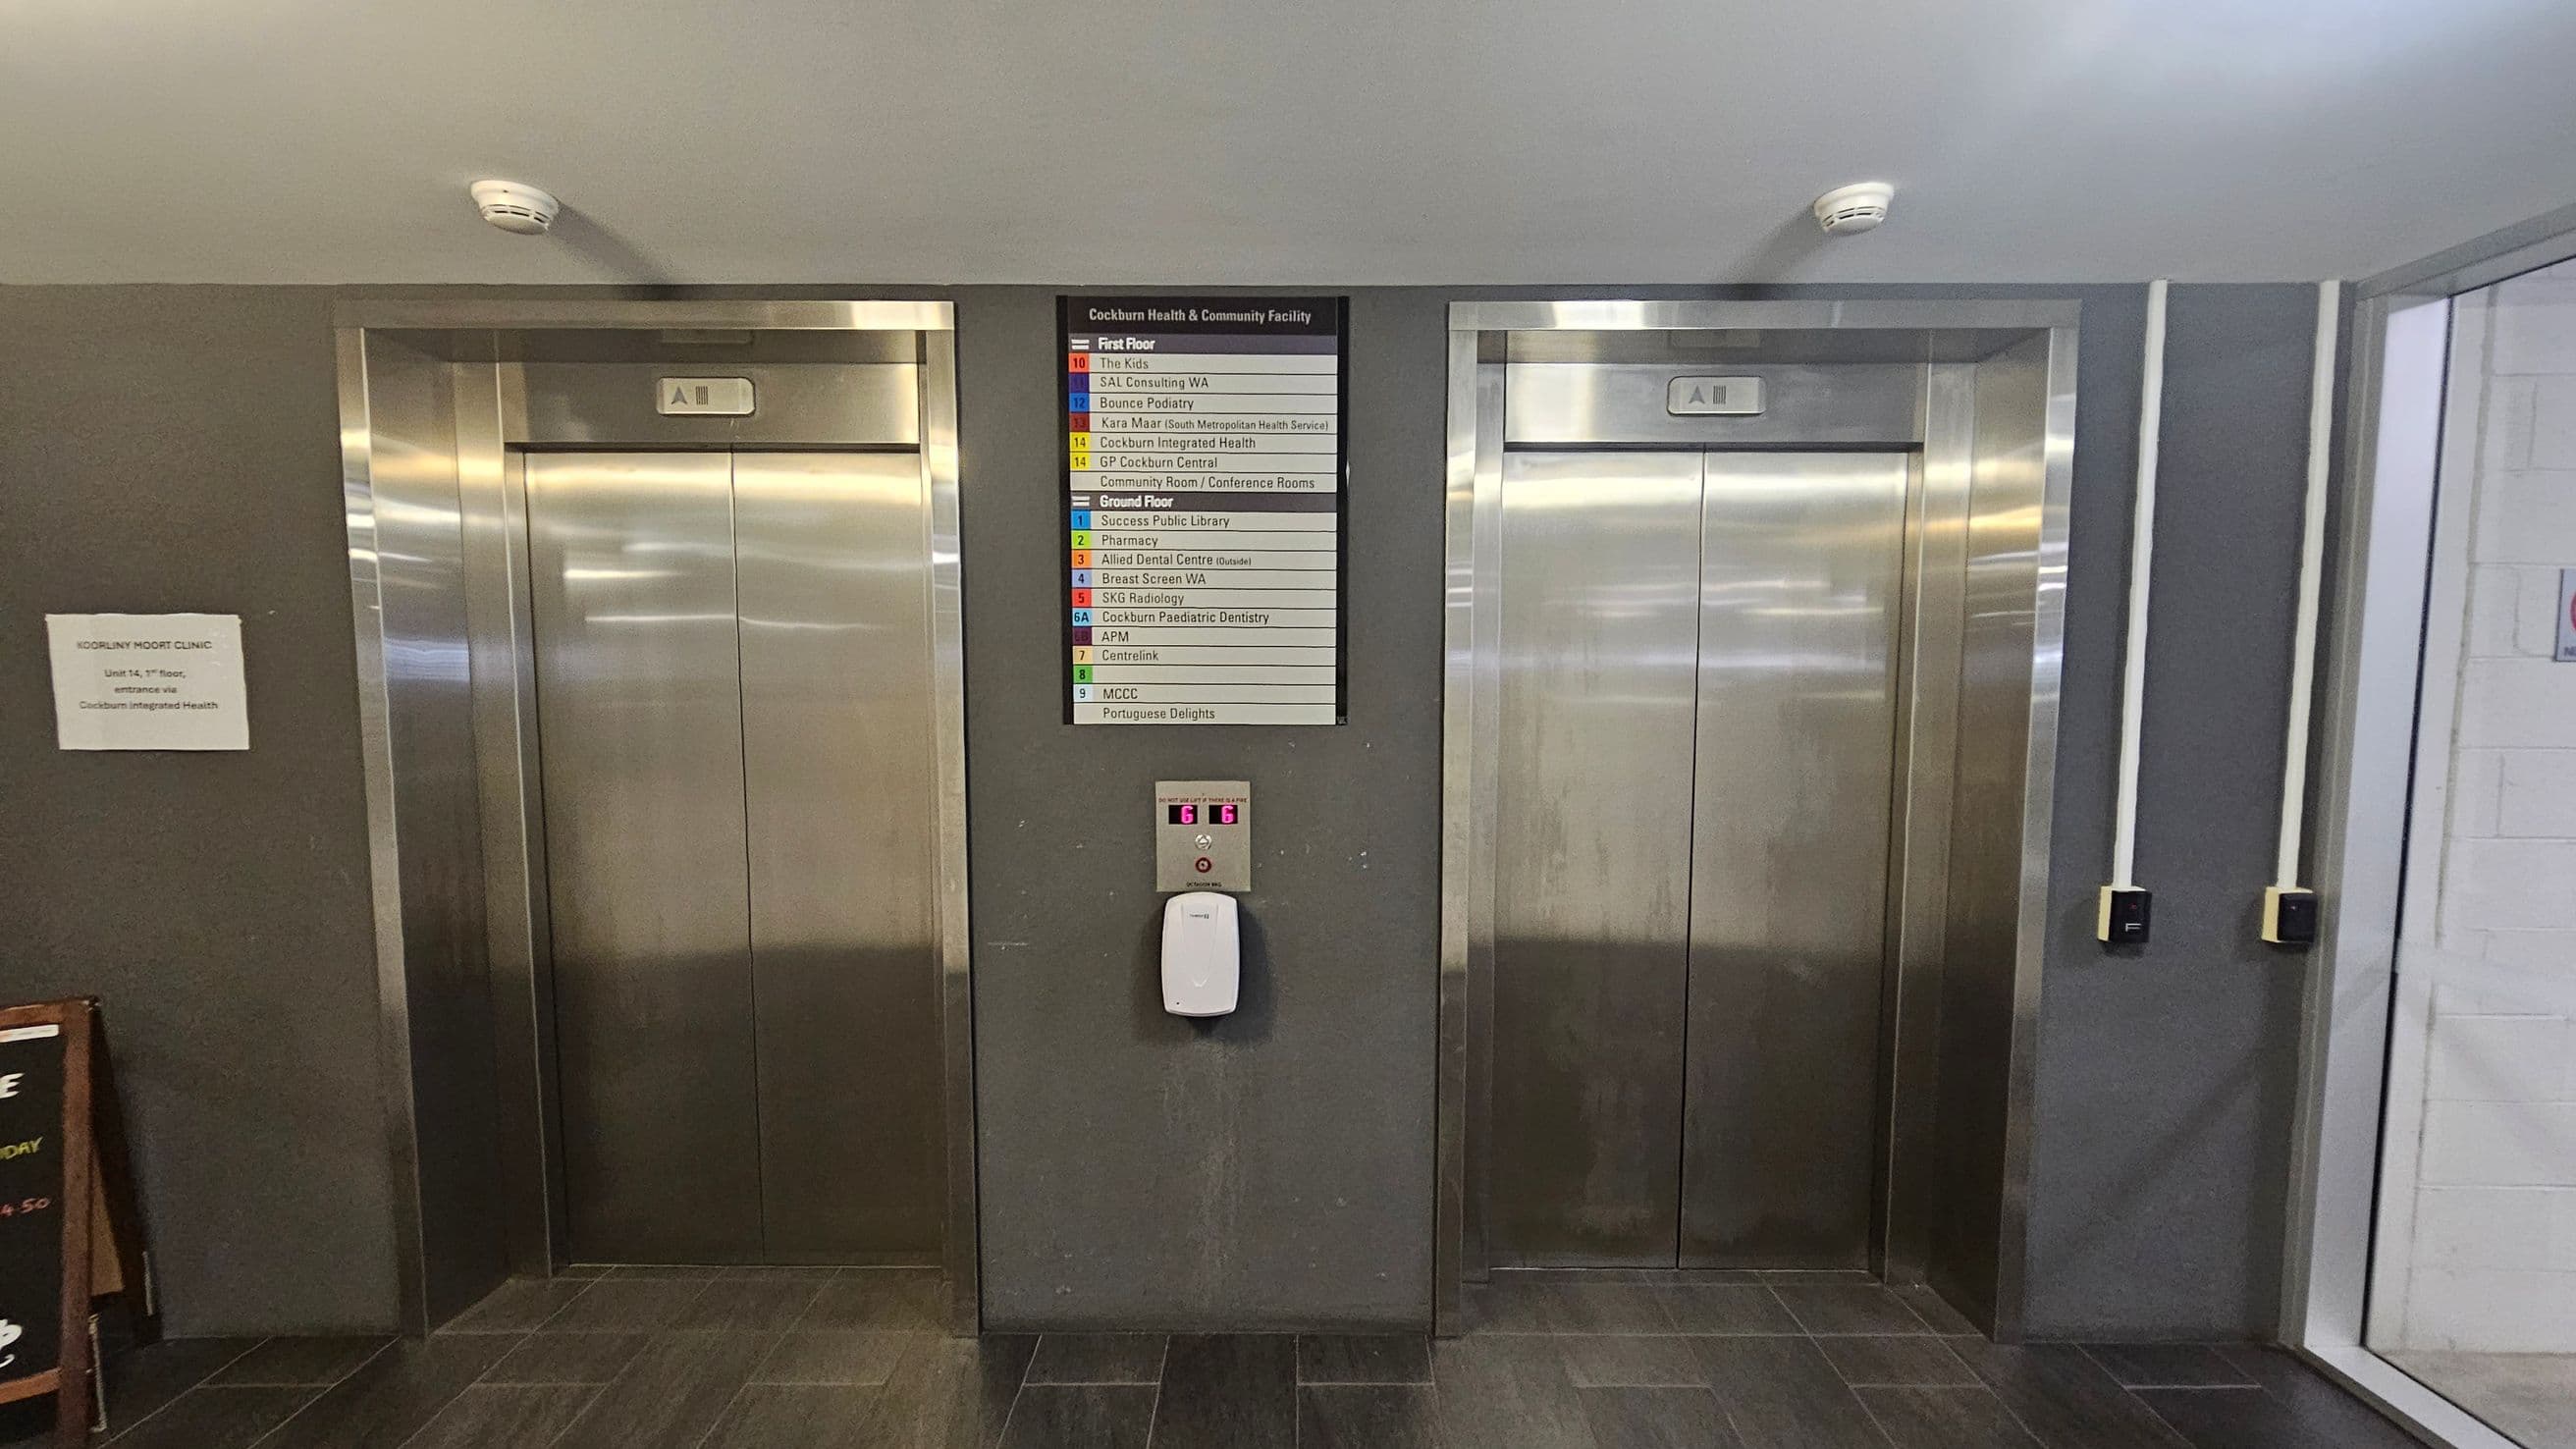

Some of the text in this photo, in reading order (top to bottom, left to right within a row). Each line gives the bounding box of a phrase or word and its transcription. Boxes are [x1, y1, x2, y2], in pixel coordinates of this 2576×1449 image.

[1089, 308, 1312, 325] Cockburn Health & Community Facility
[1098, 338, 1154, 350] First Floor
[1073, 357, 1149, 369] 10 The Kids
[1100, 377, 1122, 388] SAL
[1126, 377, 1185, 391] Consulting
[1188, 377, 1208, 389] WA
[1073, 397, 1194, 411] 12 Bounce Podiatry
[1101, 417, 1127, 429] Kara
[1131, 417, 1161, 429] Maar
[1165, 419, 1195, 430] (South
[1197, 419, 1257, 432] Metropolitan
[1259, 420, 1288, 430] Health
[1290, 420, 1328, 432] Service)
[1074, 437, 1256, 452] 14 Cockburn Integrated Health
[1074, 456, 1217, 468] 14 GP Cockburn Central
[1100, 476, 1162, 489] Community
[1166, 476, 1198, 488] Room
[1208, 476, 1273, 489] Conference
[1276, 477, 1315, 489] Rooms
[1100, 496, 1174, 509] Ground Floor
[1077, 515, 1230, 529] 1 Success Public Library
[1077, 535, 1158, 548] 2 Pharmacy
[1077, 555, 1252, 567] 3 Allied Dental Centre (Outside)
[1078, 573, 1207, 584] 4 Breast Screen WA
[1078, 593, 1184, 607] 5 SKG Radiology
[1074, 612, 1269, 625] 6A Cockburn Paediatric Dentistry
[1101, 631, 1129, 642] APM
[77, 640, 212, 650] KOORLINY MOORT CLINIC
[1079, 649, 1158, 661] 7 Centrelink
[104, 669, 126, 677] Unit
[129, 669, 142, 679] 14,
[160, 669, 186, 679] floor,
[1079, 670, 1086, 679] 8
[114, 685, 160, 694] entrance
[1079, 688, 1138, 700] 9 MCCC
[79, 700, 218, 712] Cockburn Integrated Health
[1103, 708, 1215, 722] Portuguese Delights
